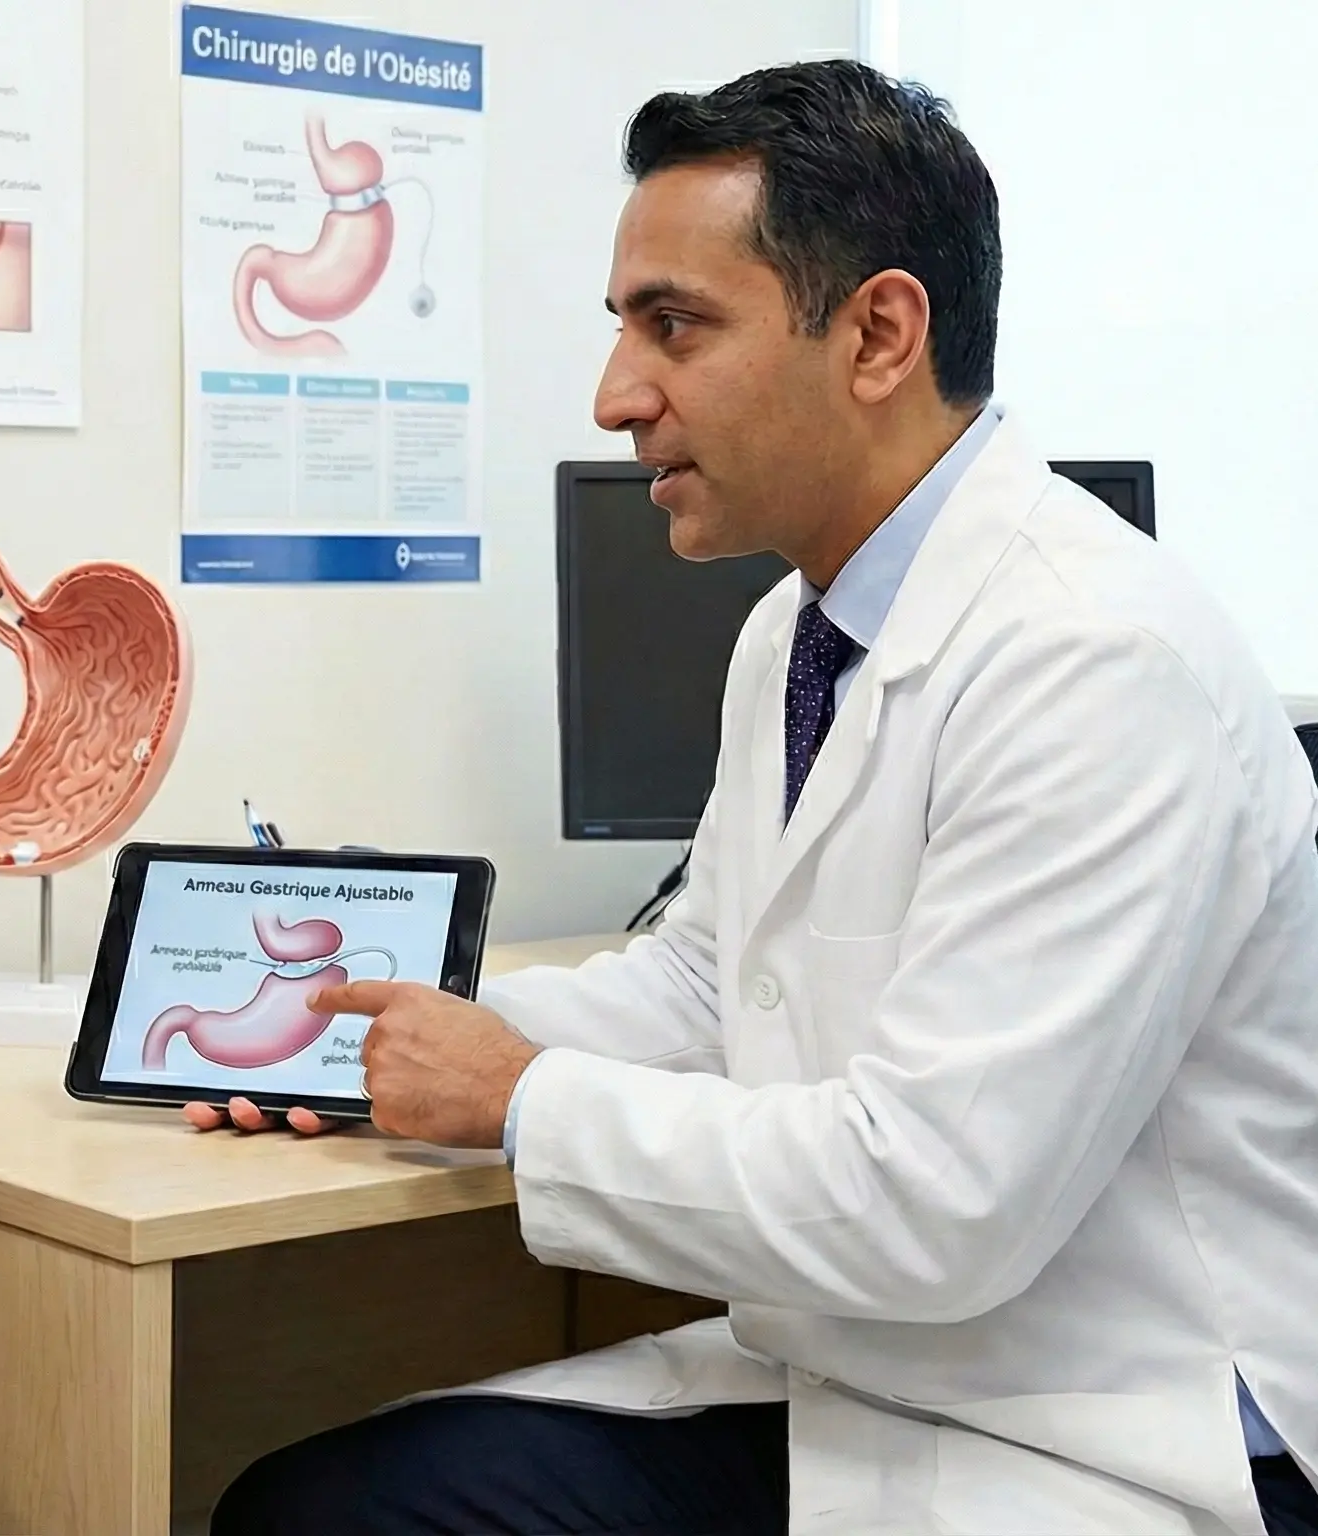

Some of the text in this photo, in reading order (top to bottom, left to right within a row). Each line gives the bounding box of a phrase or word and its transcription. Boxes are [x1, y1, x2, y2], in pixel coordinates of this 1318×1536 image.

[192, 25, 472, 92] Chirurgie de l'Obésité
[249, 879, 331, 902] Gastrique
